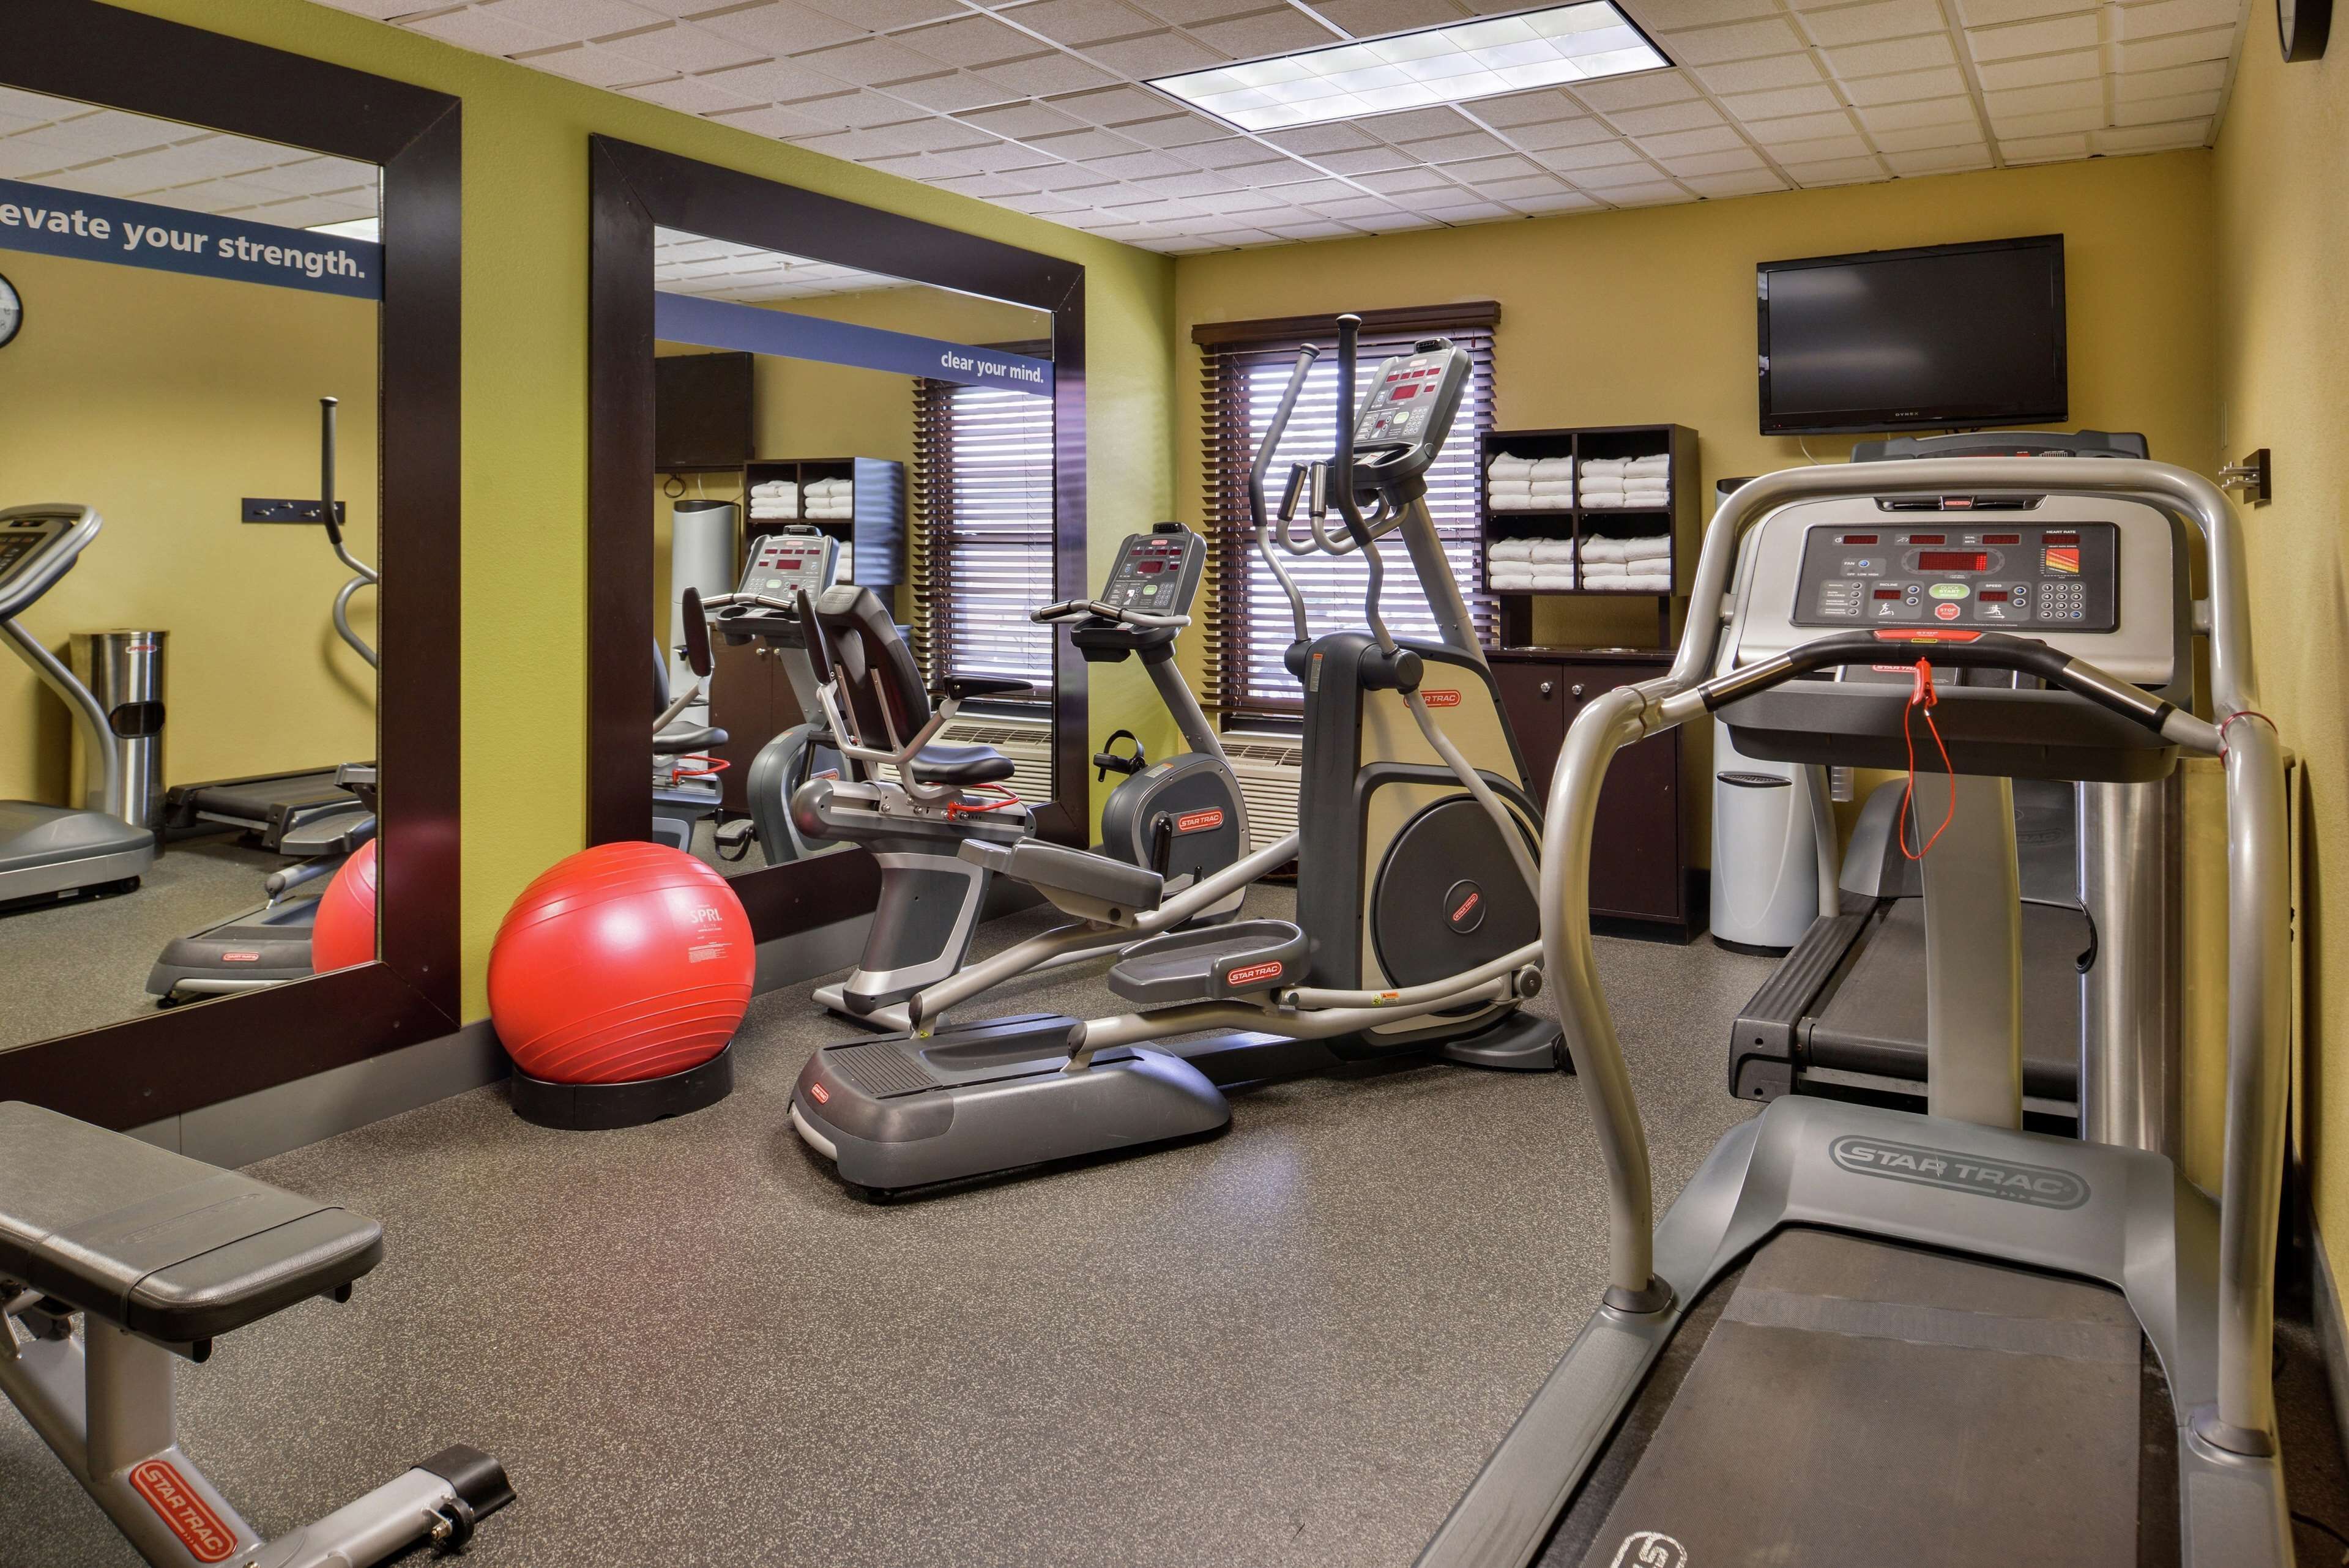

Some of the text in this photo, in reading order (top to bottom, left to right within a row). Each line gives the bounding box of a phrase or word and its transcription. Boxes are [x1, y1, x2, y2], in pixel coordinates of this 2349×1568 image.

[0, 204, 365, 278] evate your strength.
[941, 351, 1044, 383] clear your mind.
[1181, 818, 1199, 827] STAR
[1231, 966, 1278, 980] STAR TRAC
[1844, 1146, 2065, 1195] STAR TRAC
[143, 1468, 224, 1550] STAR TRAC
